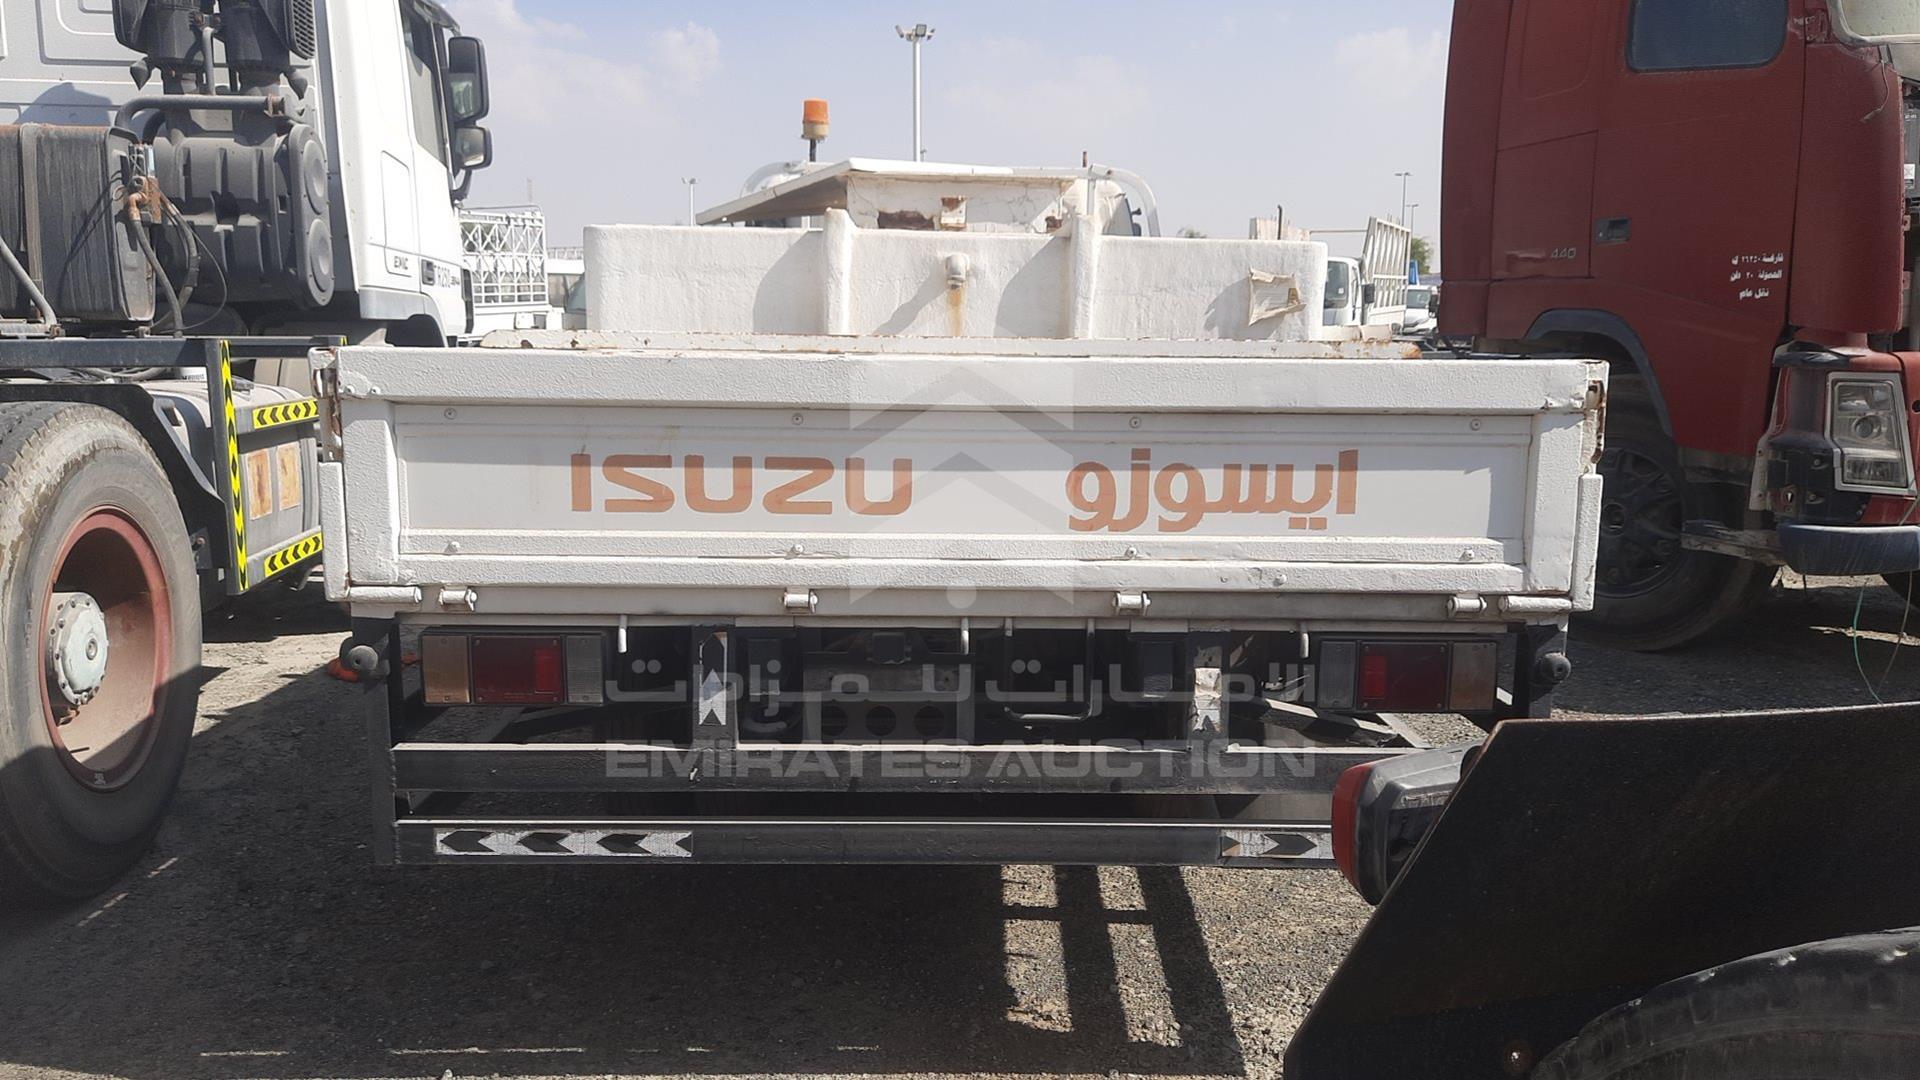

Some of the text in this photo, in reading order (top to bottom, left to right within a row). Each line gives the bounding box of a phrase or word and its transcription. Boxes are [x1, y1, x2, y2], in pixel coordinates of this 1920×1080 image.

[1552, 247, 1576, 259] 440
[571, 454, 912, 516] ISUZU
[1065, 447, 1359, 532] ايسوزو
